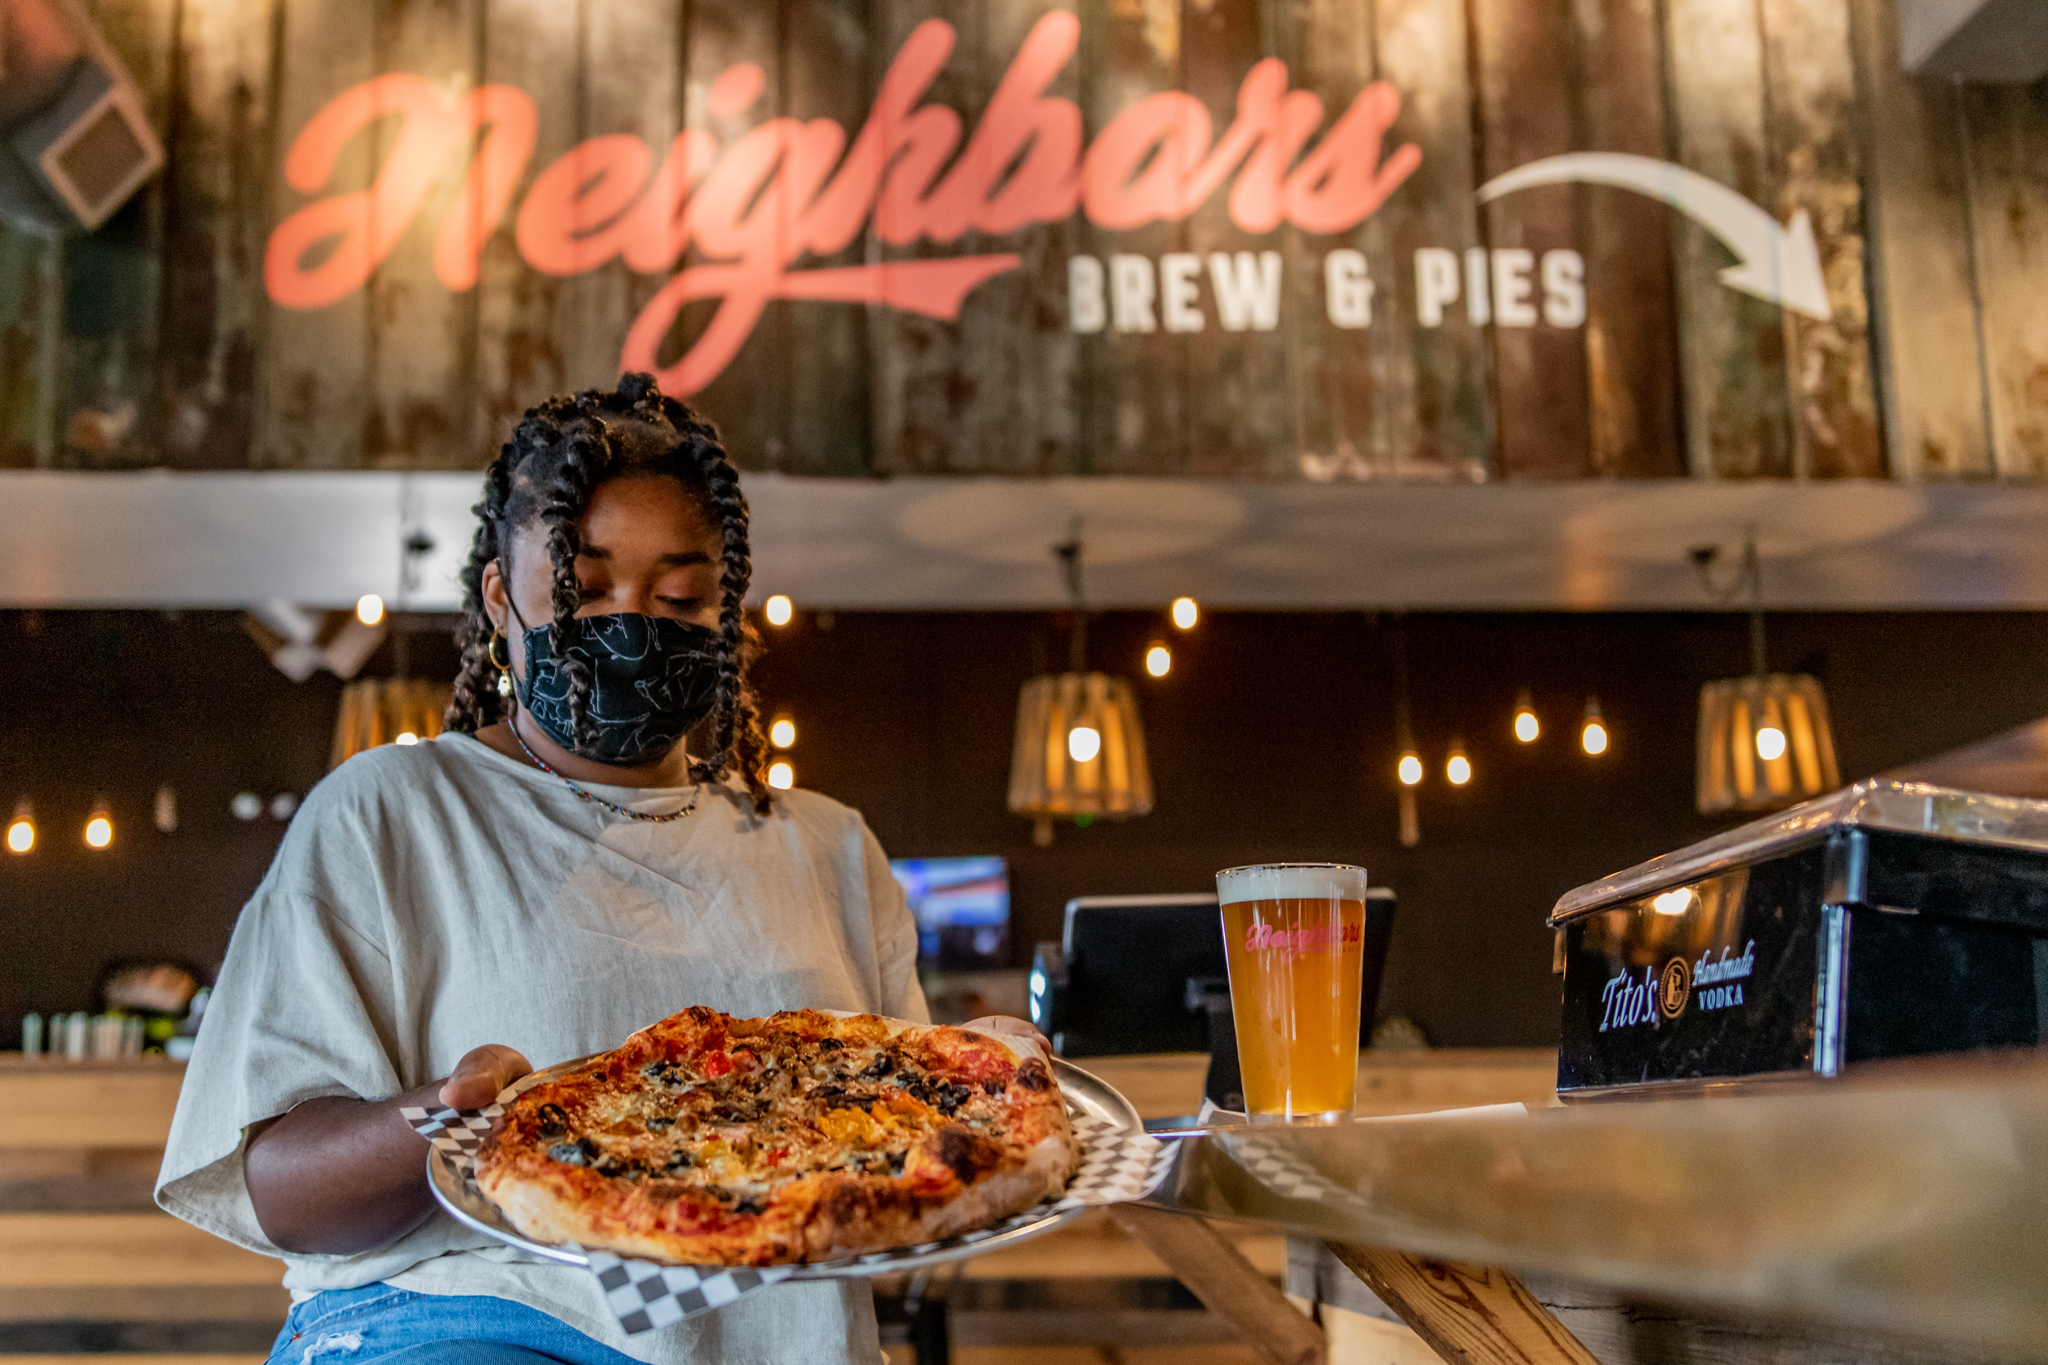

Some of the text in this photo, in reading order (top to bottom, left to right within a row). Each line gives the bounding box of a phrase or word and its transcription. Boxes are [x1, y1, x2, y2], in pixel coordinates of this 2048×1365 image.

[264, 10, 1422, 396] Neighbors
[1069, 246, 1587, 333] BREW & PIES
[1692, 939, 1755, 987] Handmade
[1698, 984, 1744, 1011] VODKA
